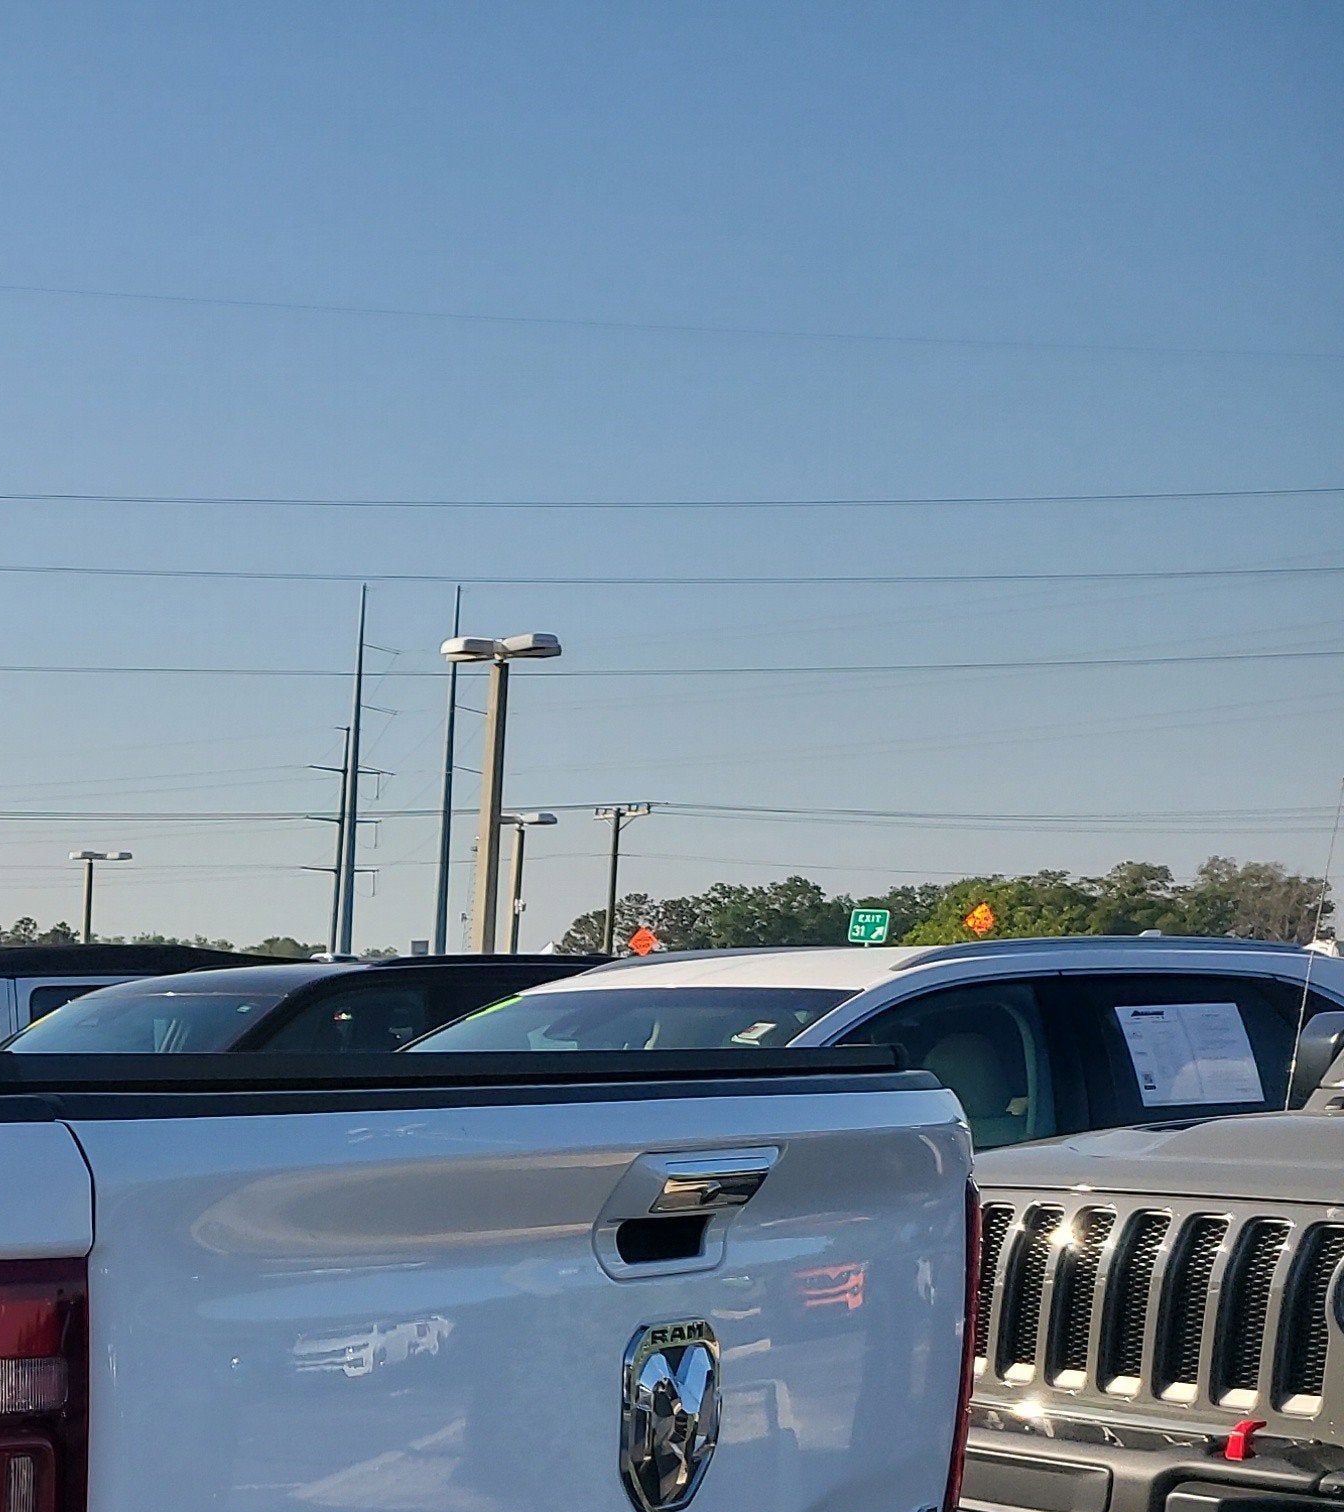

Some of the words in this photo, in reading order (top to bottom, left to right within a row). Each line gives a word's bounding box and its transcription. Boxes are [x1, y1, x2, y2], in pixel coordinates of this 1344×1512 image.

[857, 913, 882, 923] EXIT
[852, 924, 865, 937] 31
[650, 1321, 704, 1345] RAM
